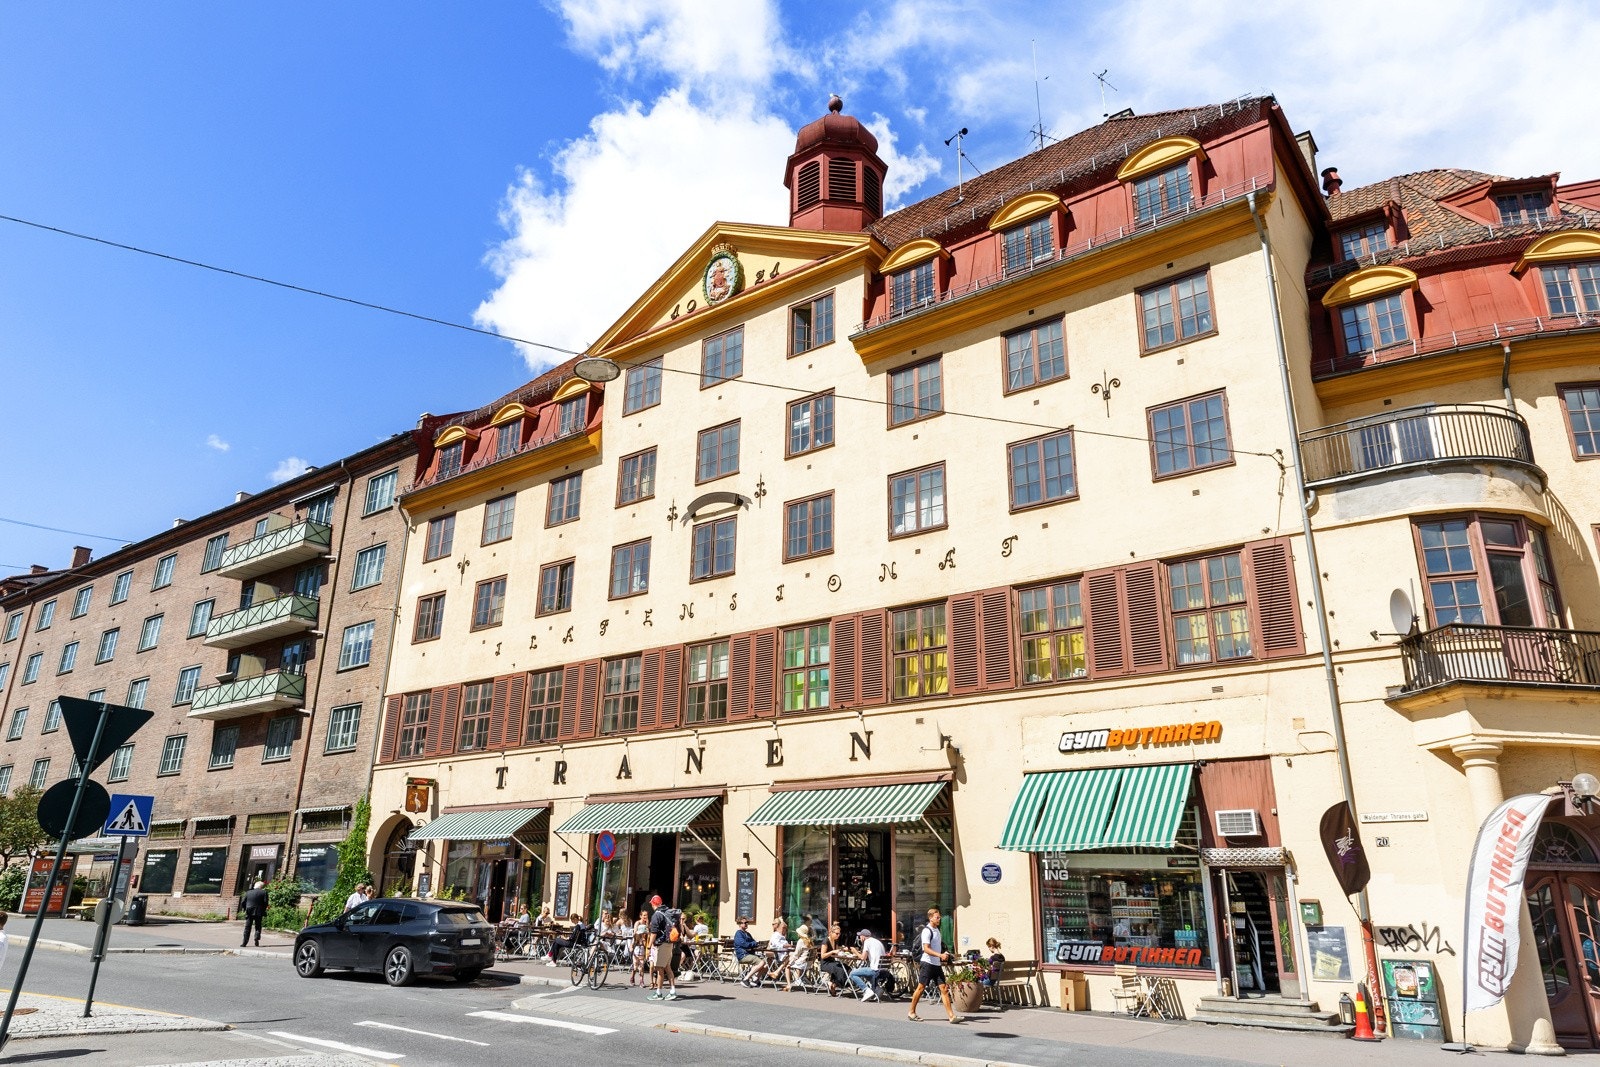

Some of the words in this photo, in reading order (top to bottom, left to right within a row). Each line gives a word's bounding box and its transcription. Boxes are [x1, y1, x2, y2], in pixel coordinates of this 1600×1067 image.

[495, 730, 874, 790] TRANEN
[1376, 838, 1389, 847] 70
[1042, 859, 1070, 870] TRY
[1044, 870, 1069, 881] ING
